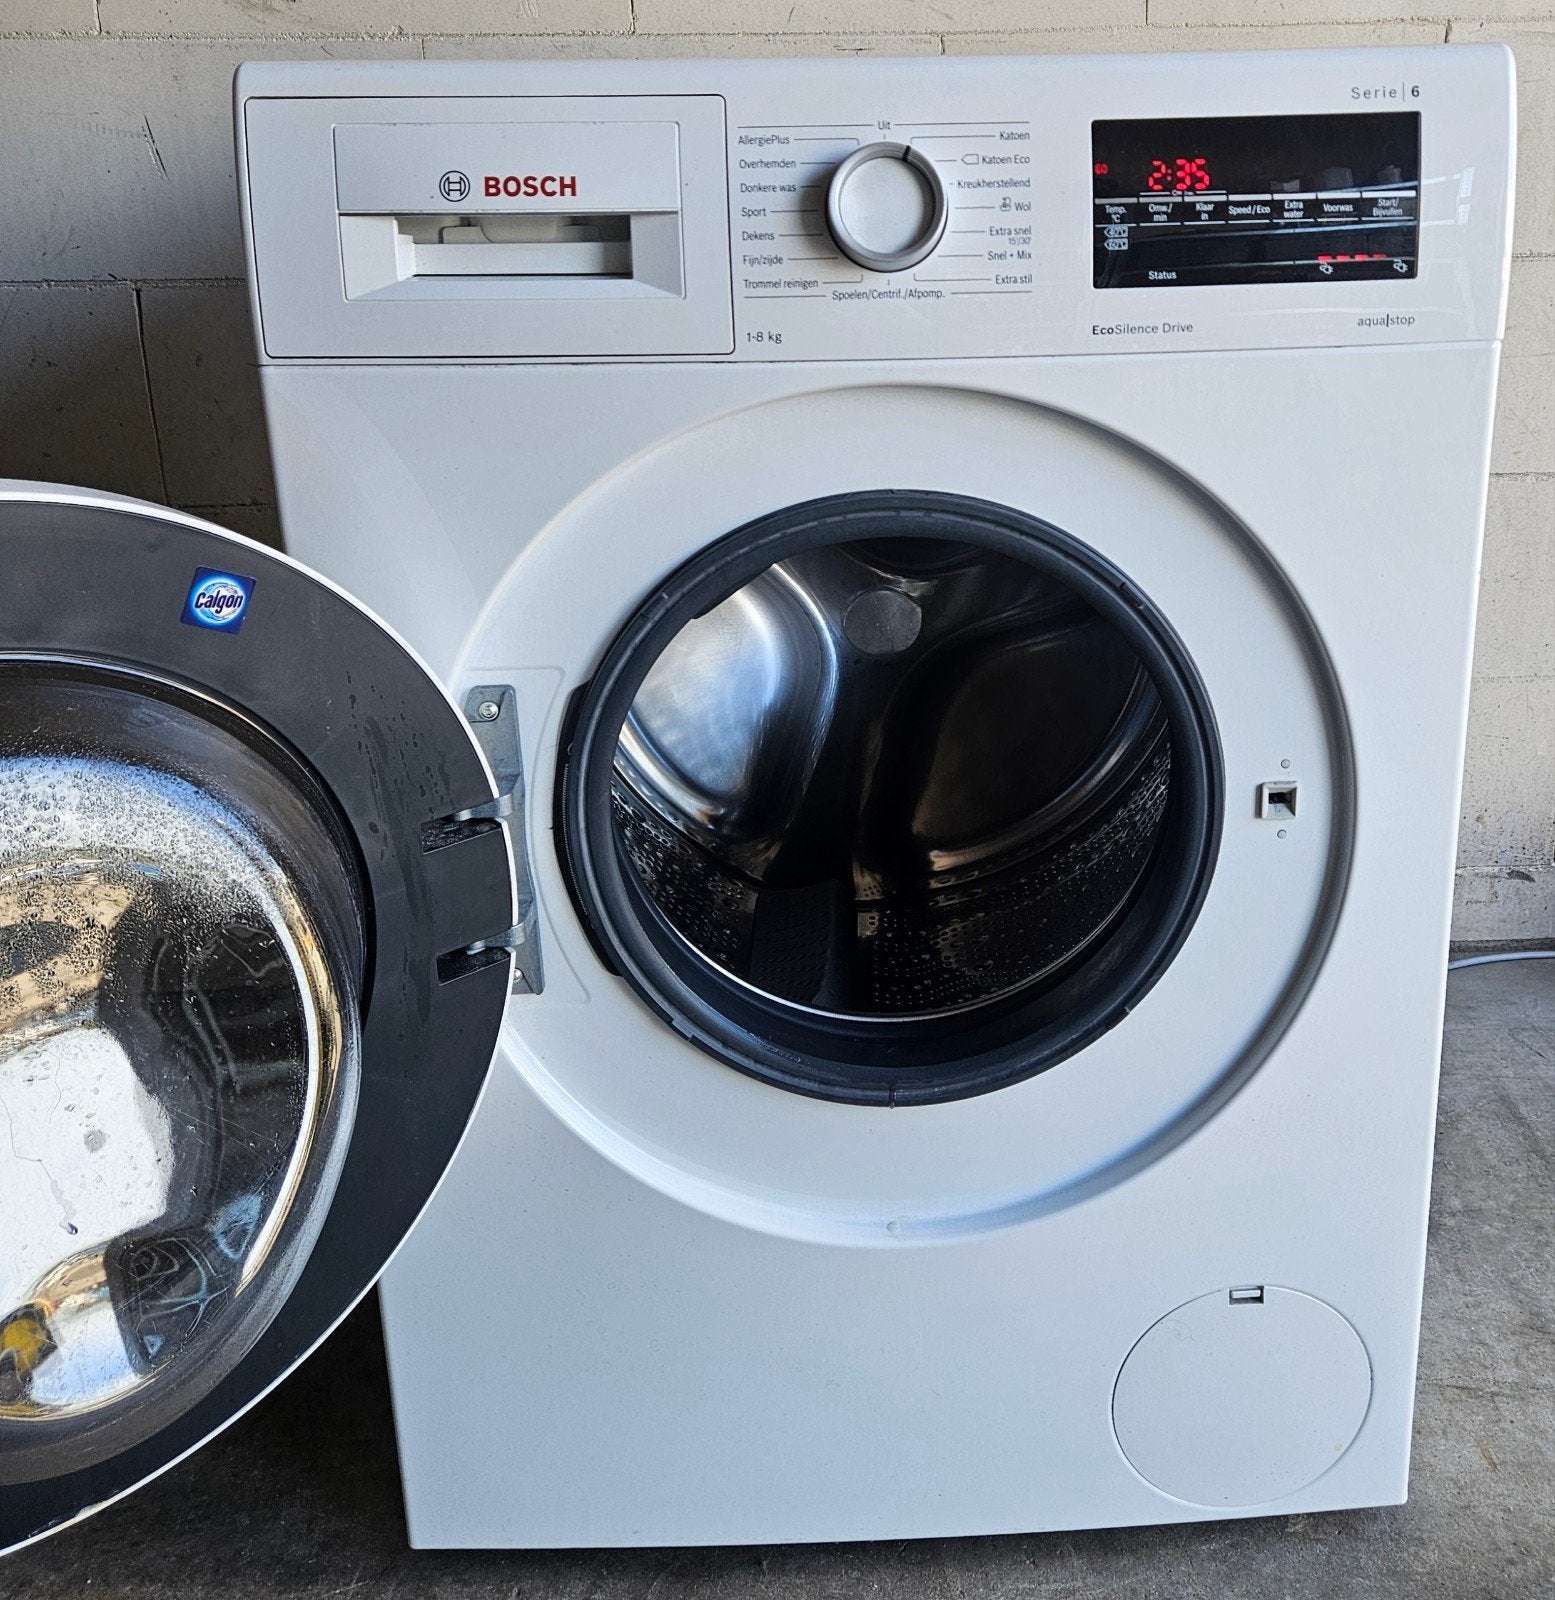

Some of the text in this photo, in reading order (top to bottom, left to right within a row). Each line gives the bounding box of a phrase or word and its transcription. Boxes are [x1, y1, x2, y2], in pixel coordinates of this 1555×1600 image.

[1350, 85, 1420, 100] Serie 6
[877, 120, 891, 130] Uit
[738, 134, 790, 147] AllergiePlus
[999, 131, 1030, 141] Katoen
[738, 158, 797, 169] Overhemden
[982, 154, 1031, 165] Katoen Eco
[1147, 158, 1211, 191] 2:35
[484, 176, 577, 197] BOSCH
[740, 183, 797, 193] Donkere was
[957, 178, 1031, 189] Kreukherstellend
[1014, 202, 1032, 212] Wol
[1284, 200, 1304, 210] Extra
[1322, 203, 1354, 212] Voorwas
[741, 207, 767, 218] Sport
[1283, 209, 1304, 218] water
[989, 224, 1032, 236] Extra snel
[742, 231, 775, 241] Dekens
[743, 254, 784, 267] Fijn/zijde
[988, 250, 1007, 261] Snel
[1017, 250, 1032, 260] Mix
[995, 273, 1033, 285] Extra stil
[1148, 270, 1178, 280] Status
[743, 278, 819, 291] Trommel reinigen
[1092, 322, 1194, 336] EcoSilence Drive
[746, 330, 783, 344] 1-8 kg
[193, 589, 244, 615] Calgon
